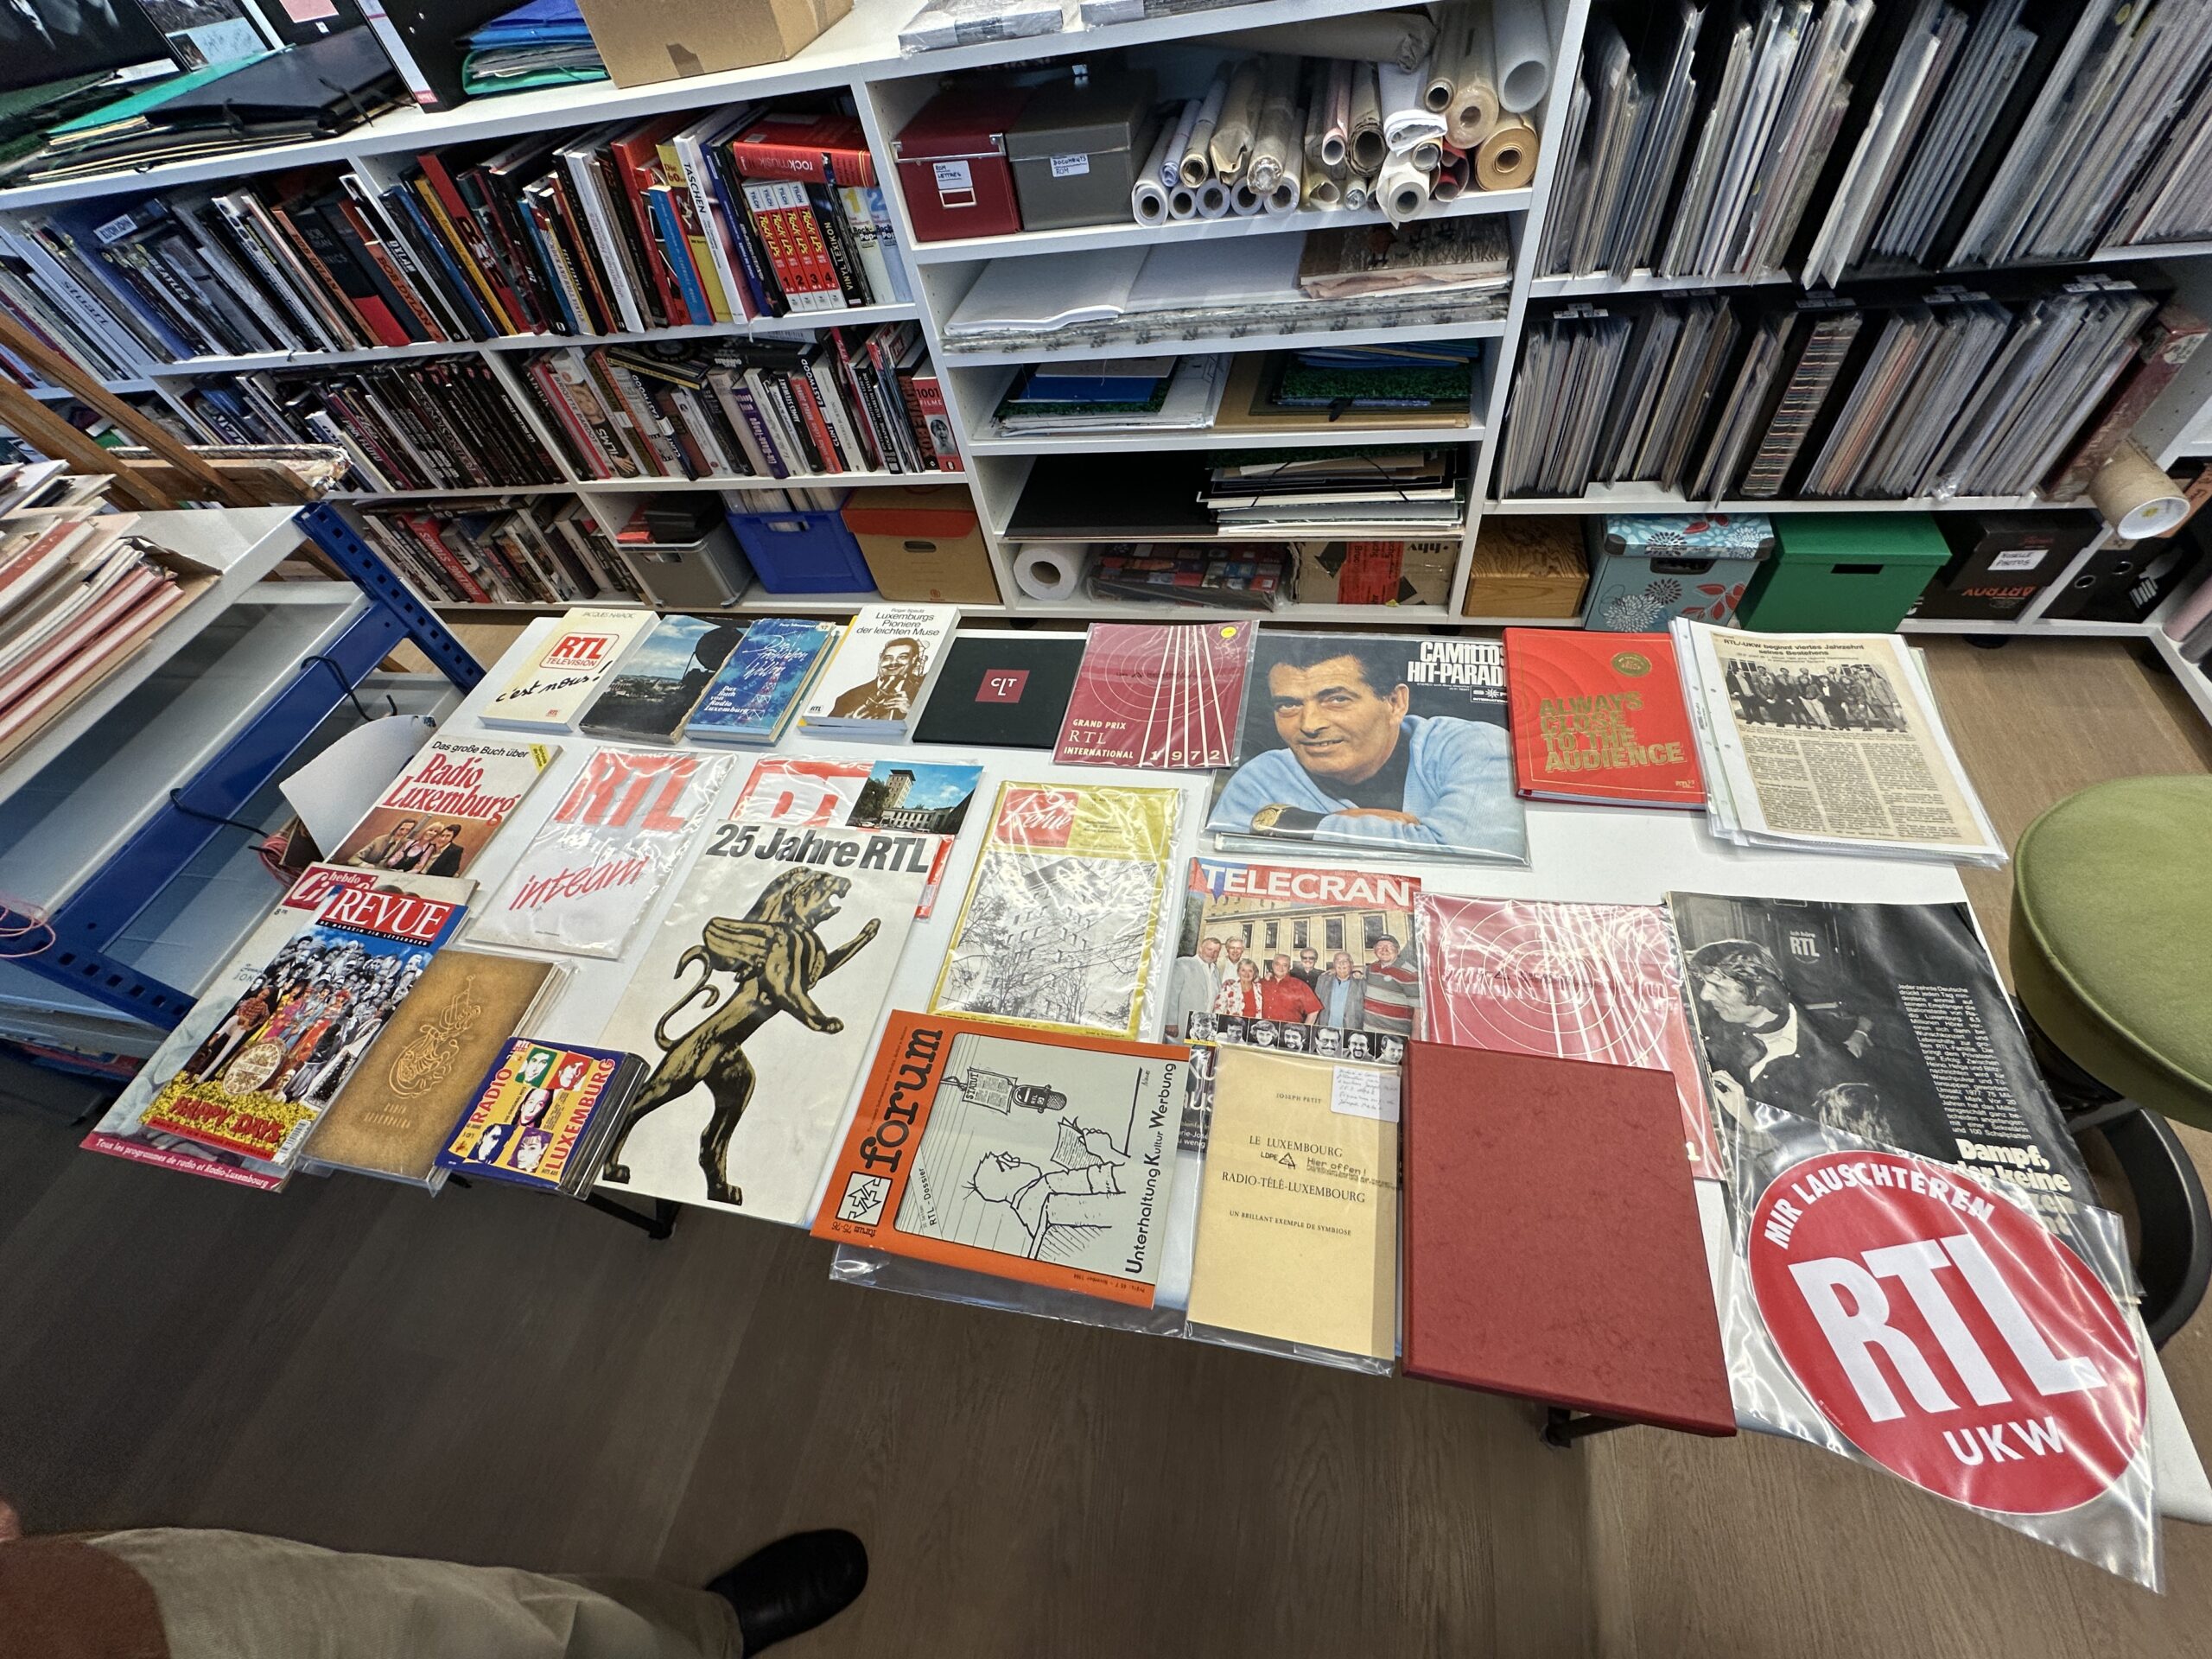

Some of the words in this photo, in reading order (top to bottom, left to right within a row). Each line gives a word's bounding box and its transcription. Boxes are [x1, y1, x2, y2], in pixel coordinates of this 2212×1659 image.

[683, 162, 706, 213] TASCHEN
[750, 191, 761, 209] TILCH
[763, 188, 773, 207] TILCH
[779, 188, 789, 205] TILCH
[792, 186, 804, 203] TILCH
[844, 188, 861, 213] 1
[868, 188, 887, 212] 2
[824, 222, 844, 264] LEXIKON
[387, 240, 416, 273] DYLAN
[149, 258, 190, 301] BEATLES
[311, 256, 338, 291] DYLAN
[783, 276, 791, 287] 1
[795, 275, 804, 286] 2
[810, 273, 818, 284] 3
[825, 271, 833, 283] 4
[840, 264, 854, 291] VINYL
[378, 257, 399, 284] BOB
[397, 283, 433, 327] DYLAN
[778, 378, 794, 404] STEWART
[800, 358, 824, 407] EASTWOOD
[917, 388, 941, 398] 1001
[632, 374, 659, 419] EASTWOOD
[787, 404, 801, 423] JAMES
[576, 414, 598, 443] BARDOT
[826, 423, 840, 447] CLINT
[420, 531, 451, 562] STONES
[448, 564, 480, 597] ROLLING
[875, 612, 936, 621] Luxemburgs
[881, 620, 922, 628] Pioniere
[856, 626, 874, 635] der
[874, 626, 912, 636] leichten
[551, 636, 608, 659] RTL
[546, 658, 600, 667] TELEVISION
[1407, 661, 1507, 687] HIT-PARAD
[703, 705, 749, 715] Luxemburg
[1539, 691, 1643, 717] ALWAYS
[1072, 718, 1103, 728] GRAND
[1105, 721, 1127, 729] PRIX
[1540, 710, 1628, 734] CLOSE
[431, 741, 452, 751] Das
[452, 743, 480, 755] große
[480, 745, 505, 757] Buch
[505, 747, 530, 759] über
[1068, 729, 1107, 745] RTL
[1541, 732, 1577, 752] TO
[1586, 728, 1639, 750] THE
[1063, 746, 1134, 759] INTERNATIONAL
[1545, 741, 1688, 773] AUDIENCE
[414, 753, 486, 789] Radio
[383, 776, 522, 827] Luxemburg
[554, 752, 698, 831] RTL
[705, 823, 760, 858] 25
[754, 825, 860, 868] Jahre
[859, 835, 930, 873] RTL
[327, 870, 361, 885] hebdo
[508, 855, 651, 911] inteam
[1201, 864, 1410, 907] TELECRAN
[325, 887, 451, 939] REVUE
[1789, 936, 1821, 957] RTL
[469, 1067, 512, 1125] RADIO
[860, 1027, 944, 1173] forum
[1149, 1062, 1177, 1129] Werbung
[1275, 1092, 1301, 1103] JOSEPH
[1302, 1096, 1323, 1105] PETIT
[169, 1096, 234, 1127] HAPPY
[230, 1114, 285, 1143] DAYS
[545, 1058, 616, 1171] LUXEMBURG
[95, 1137, 113, 1150] Tous
[112, 1142, 124, 1154] les
[122, 1145, 167, 1163] programmes
[166, 1155, 177, 1165] de
[176, 1158, 197, 1170] radio
[196, 1162, 205, 1171] et
[1144, 1131, 1164, 1166] Kultur
[1249, 1135, 1261, 1145] LE
[1267, 1137, 1343, 1158] LUXEMBOURG
[1260, 1151, 1279, 1161] LDPE
[1306, 1156, 1328, 1168] Hier
[1955, 1138, 2051, 1170] Dampf,
[918, 1166, 931, 1202] Dossier
[1221, 1171, 1366, 1204] RADIO-TÉLÉ-LUXEMBOURG
[1994, 1165, 2072, 1192] keine
[925, 1209, 938, 1227] RTL
[1764, 1198, 1803, 1250] MIR
[1790, 1162, 1996, 1223] LAUSCHTEREN
[1124, 1166, 1161, 1274] Unterhaltung
[1230, 1210, 1240, 1218] UN
[1241, 1211, 1274, 1224] BRILLANT
[1274, 1217, 1305, 1229] EXEMPLE
[1317, 1224, 1351, 1236] SYMBIOSE
[1788, 1232, 2108, 1423] RTL
[1942, 1416, 2065, 1467] UKW
